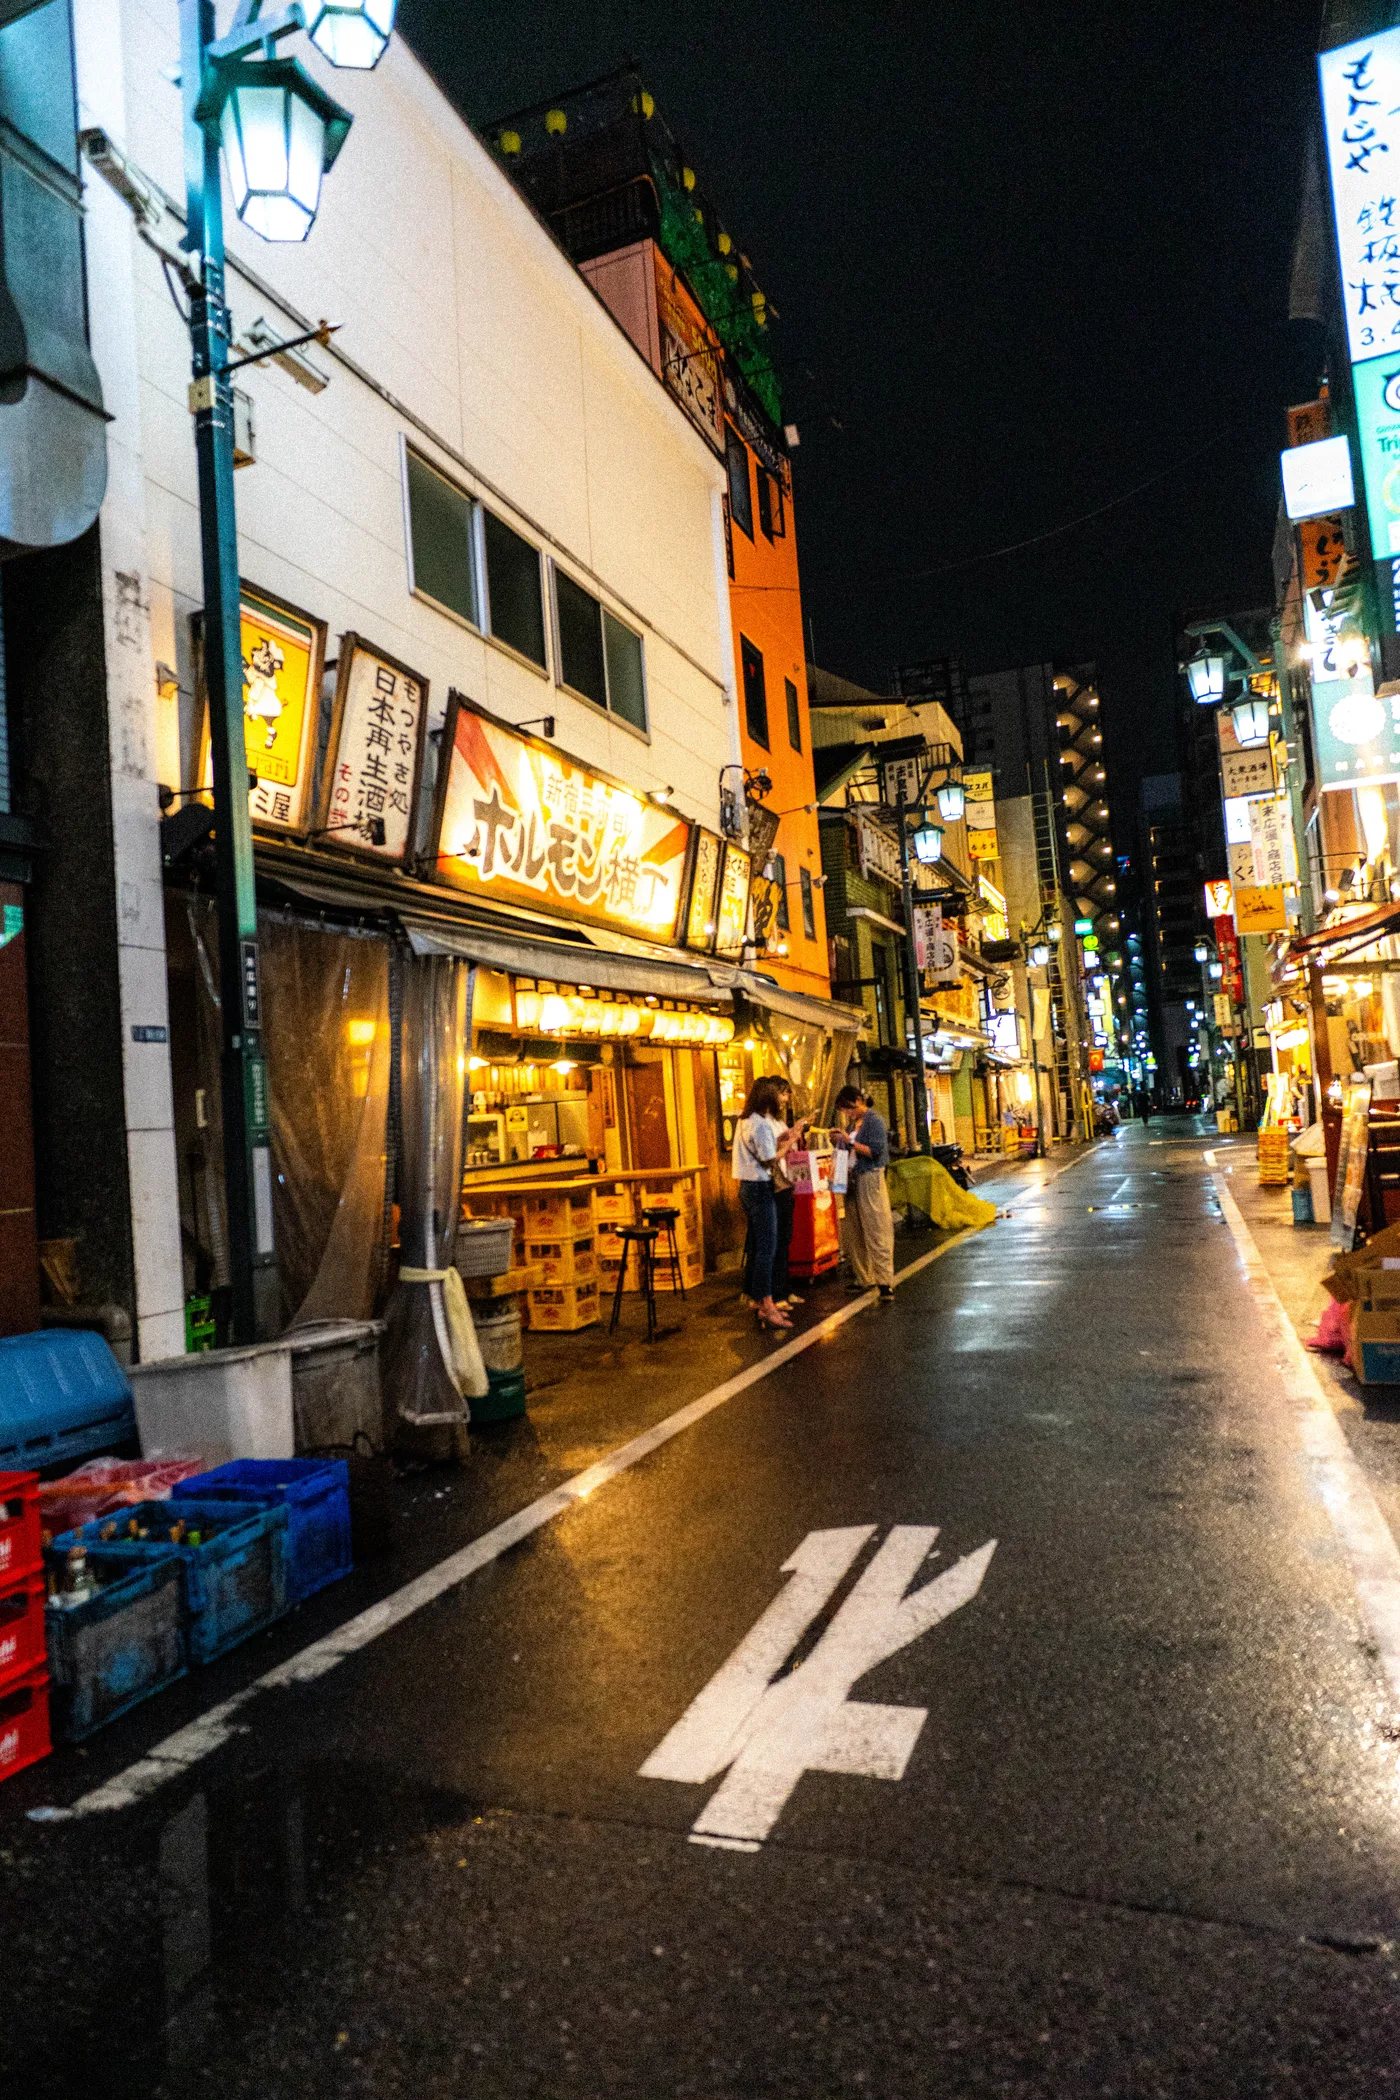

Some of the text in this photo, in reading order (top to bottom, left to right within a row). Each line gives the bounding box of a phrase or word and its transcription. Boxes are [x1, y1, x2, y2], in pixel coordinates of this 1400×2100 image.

[350, 666, 396, 843] 日本再生酒場
[388, 678, 419, 815] もつやき処
[463, 787, 670, 912] ホルモン横丁
